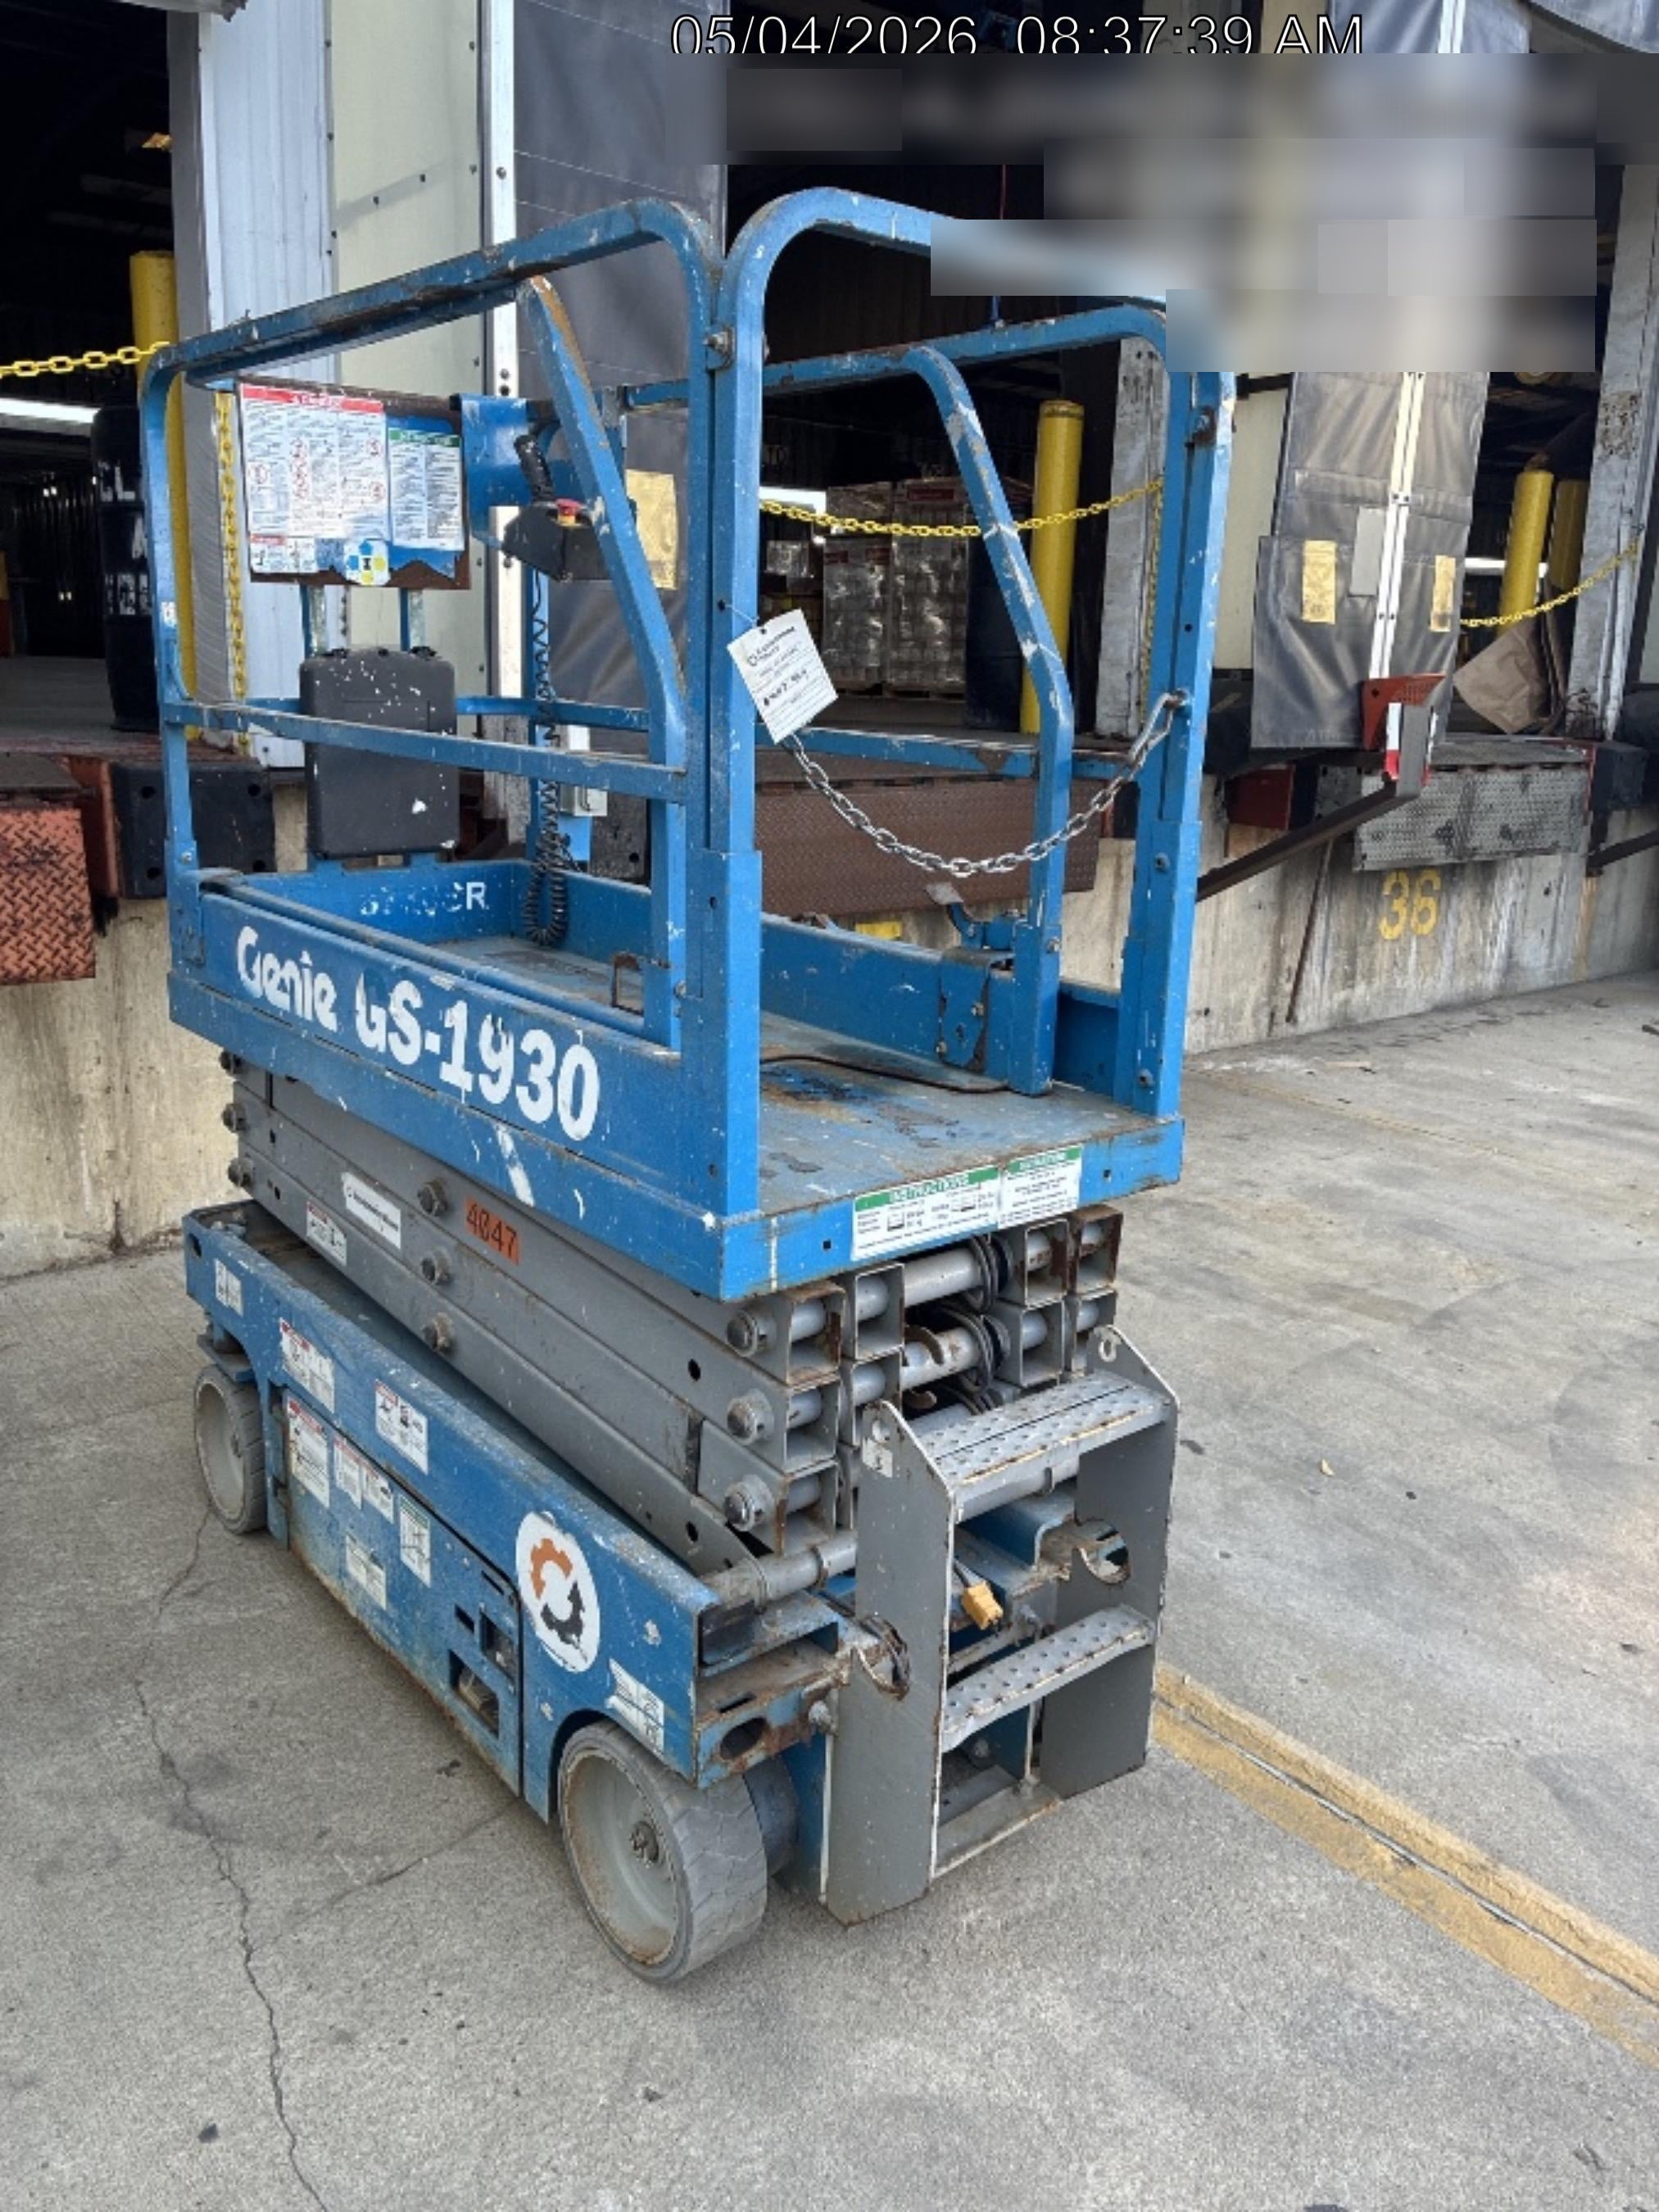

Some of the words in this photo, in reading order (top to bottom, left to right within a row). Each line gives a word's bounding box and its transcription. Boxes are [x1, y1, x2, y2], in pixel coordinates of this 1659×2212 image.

[1379, 868, 1441, 941] 36
[237, 926, 338, 1032] Genie
[355, 972, 601, 1141] GS-1930
[466, 1202, 518, 1259] 4847
